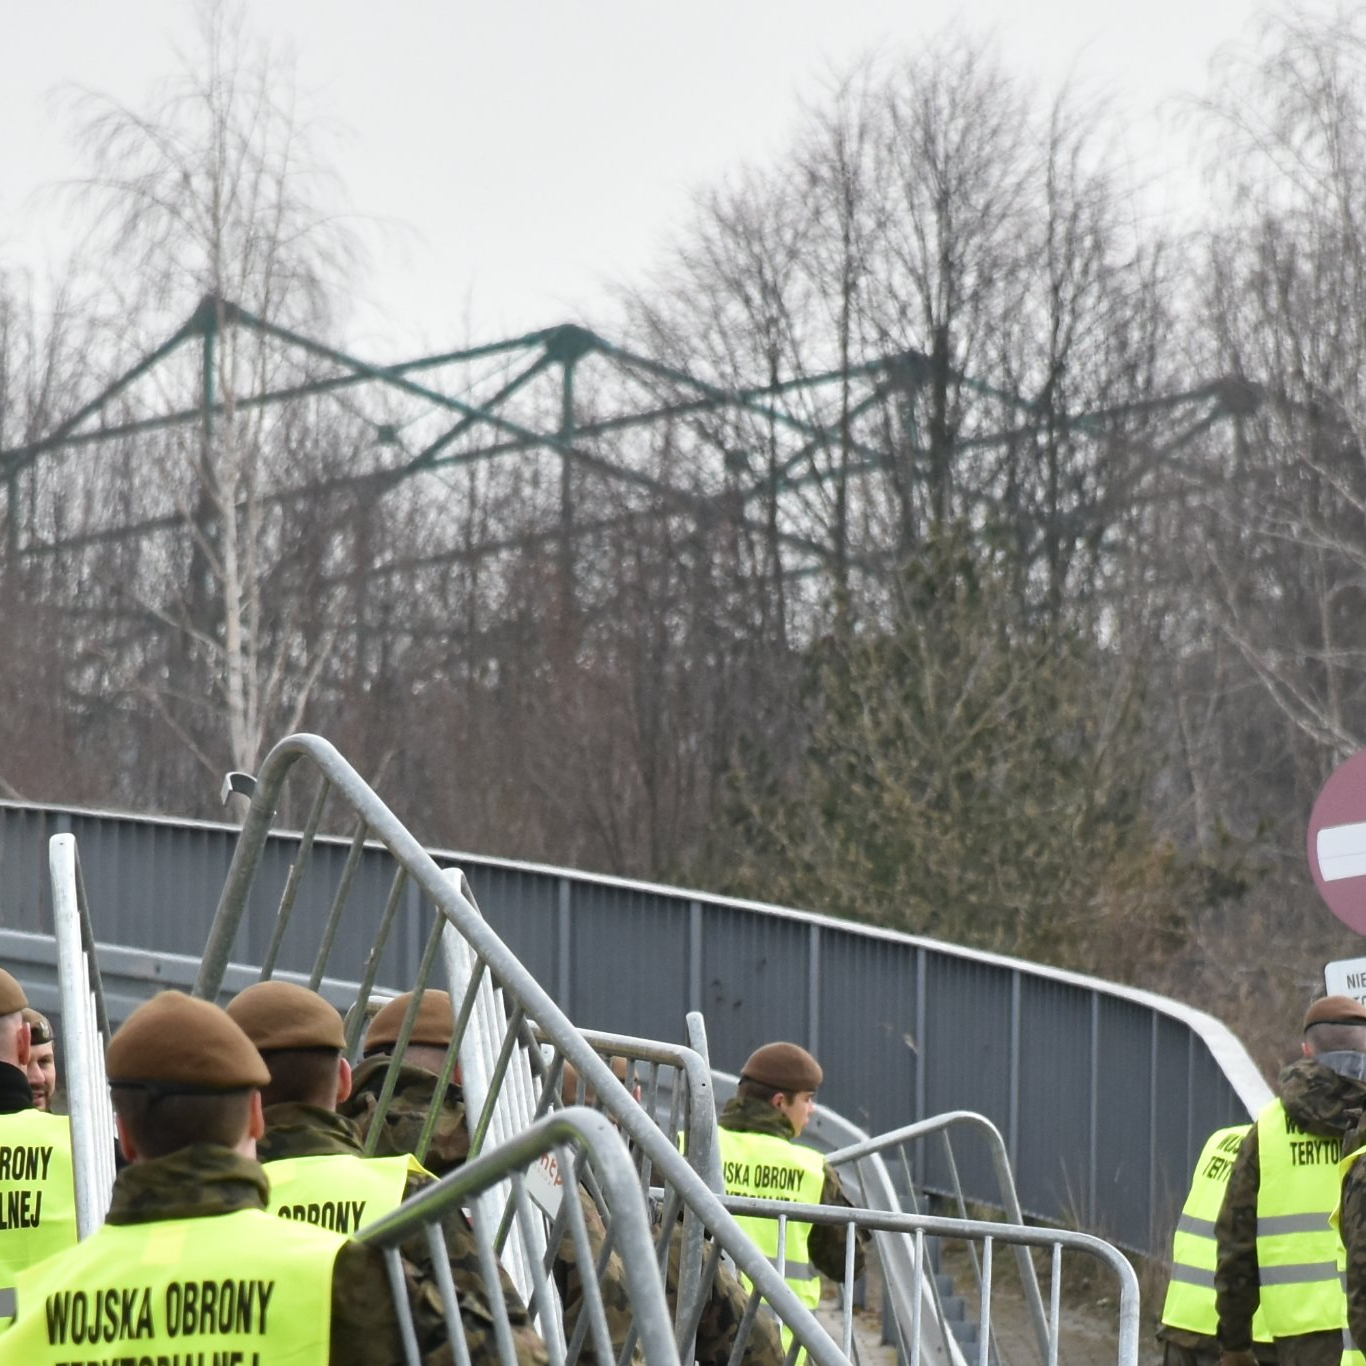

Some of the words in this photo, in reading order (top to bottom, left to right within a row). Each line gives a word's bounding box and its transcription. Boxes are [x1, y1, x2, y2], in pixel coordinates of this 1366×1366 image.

[753, 1164, 805, 1192] OBRONY
[45, 1287, 155, 1346] WOJSKA
[165, 1280, 276, 1338] OBRONY
